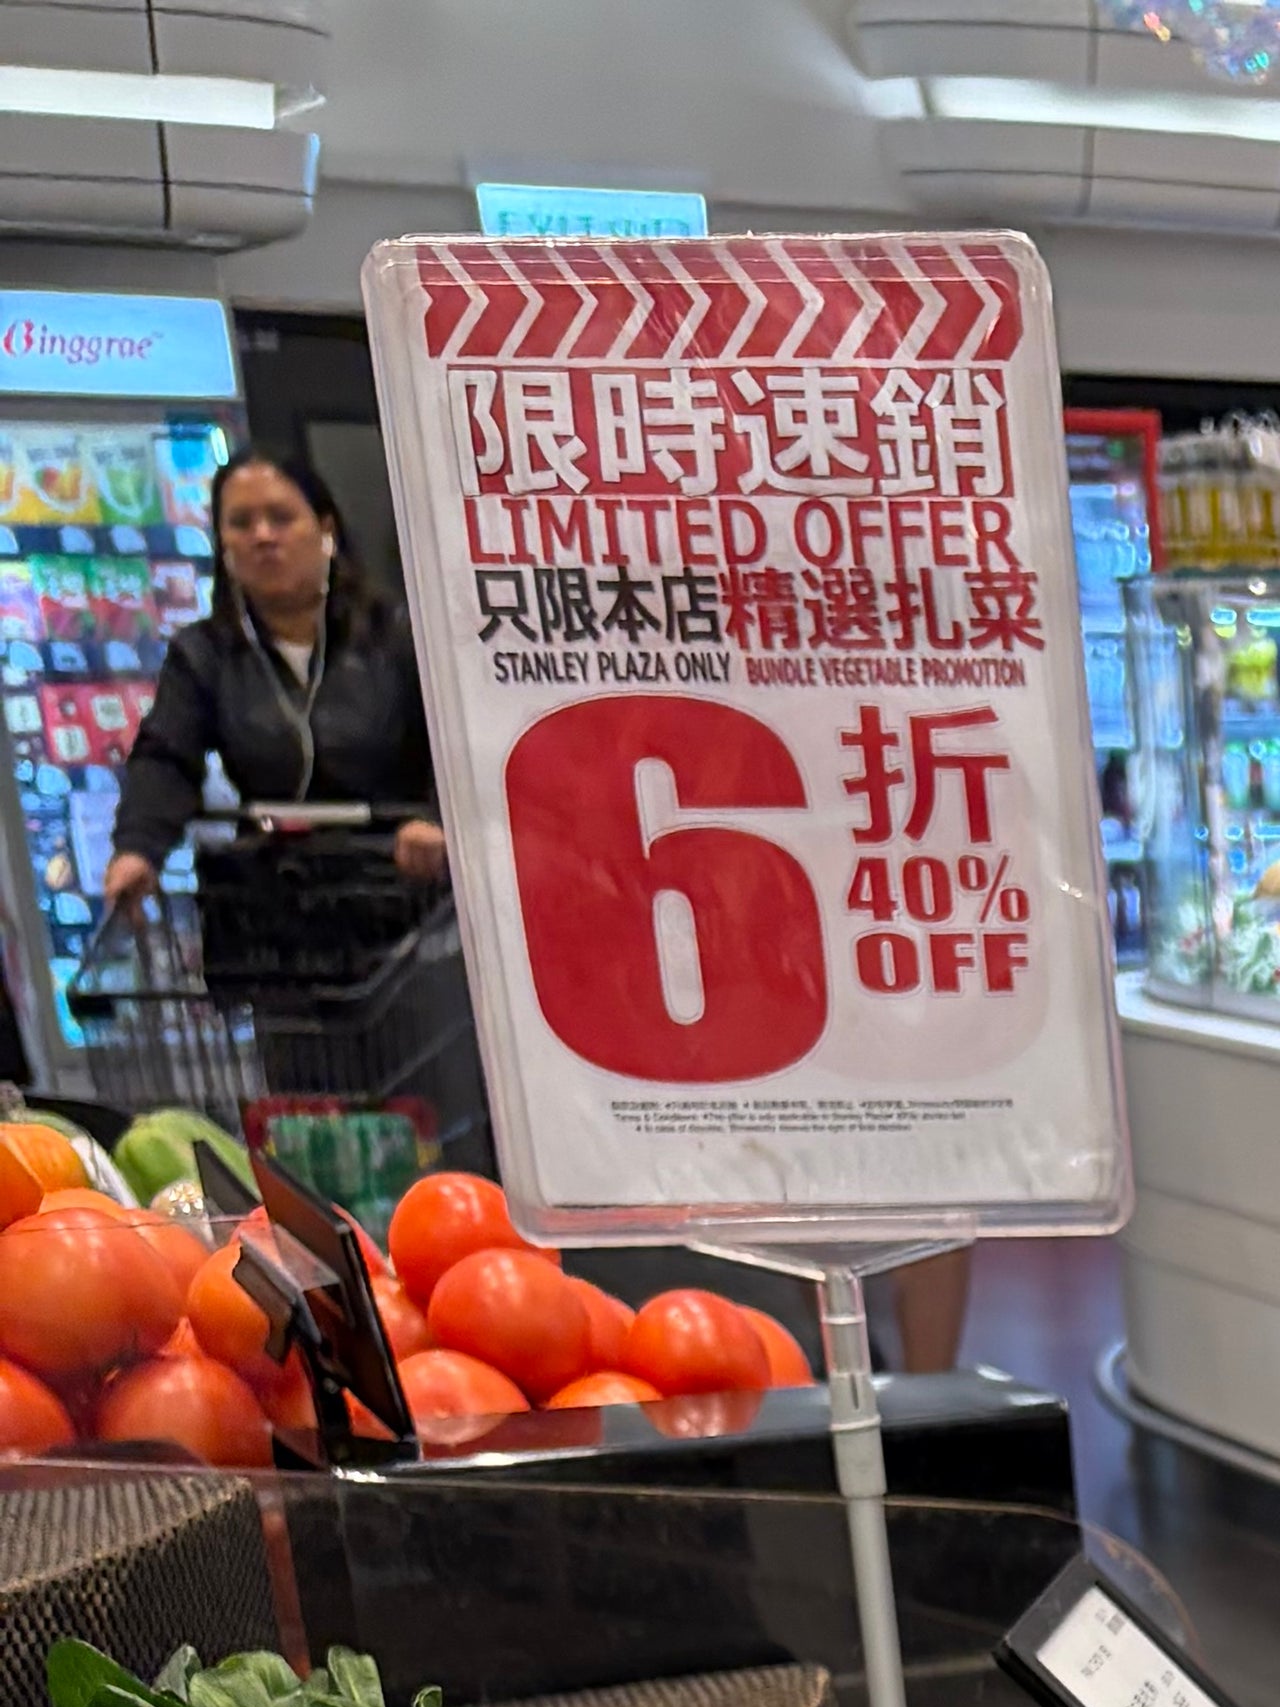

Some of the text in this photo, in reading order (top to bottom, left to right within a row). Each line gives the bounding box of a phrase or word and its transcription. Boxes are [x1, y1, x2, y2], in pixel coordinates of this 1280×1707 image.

[3, 319, 153, 365] Binggrae
[447, 368, 1008, 497] 限時速銷
[464, 498, 1021, 568] LIMITED OFFER
[493, 652, 1027, 687] STANLEY PLAZA ONLY BUNDLE VEGETABLE PROMOTION
[504, 693, 1011, 1083] 6 折
[846, 855, 1030, 923] 40%
[854, 932, 1030, 993] OFF
